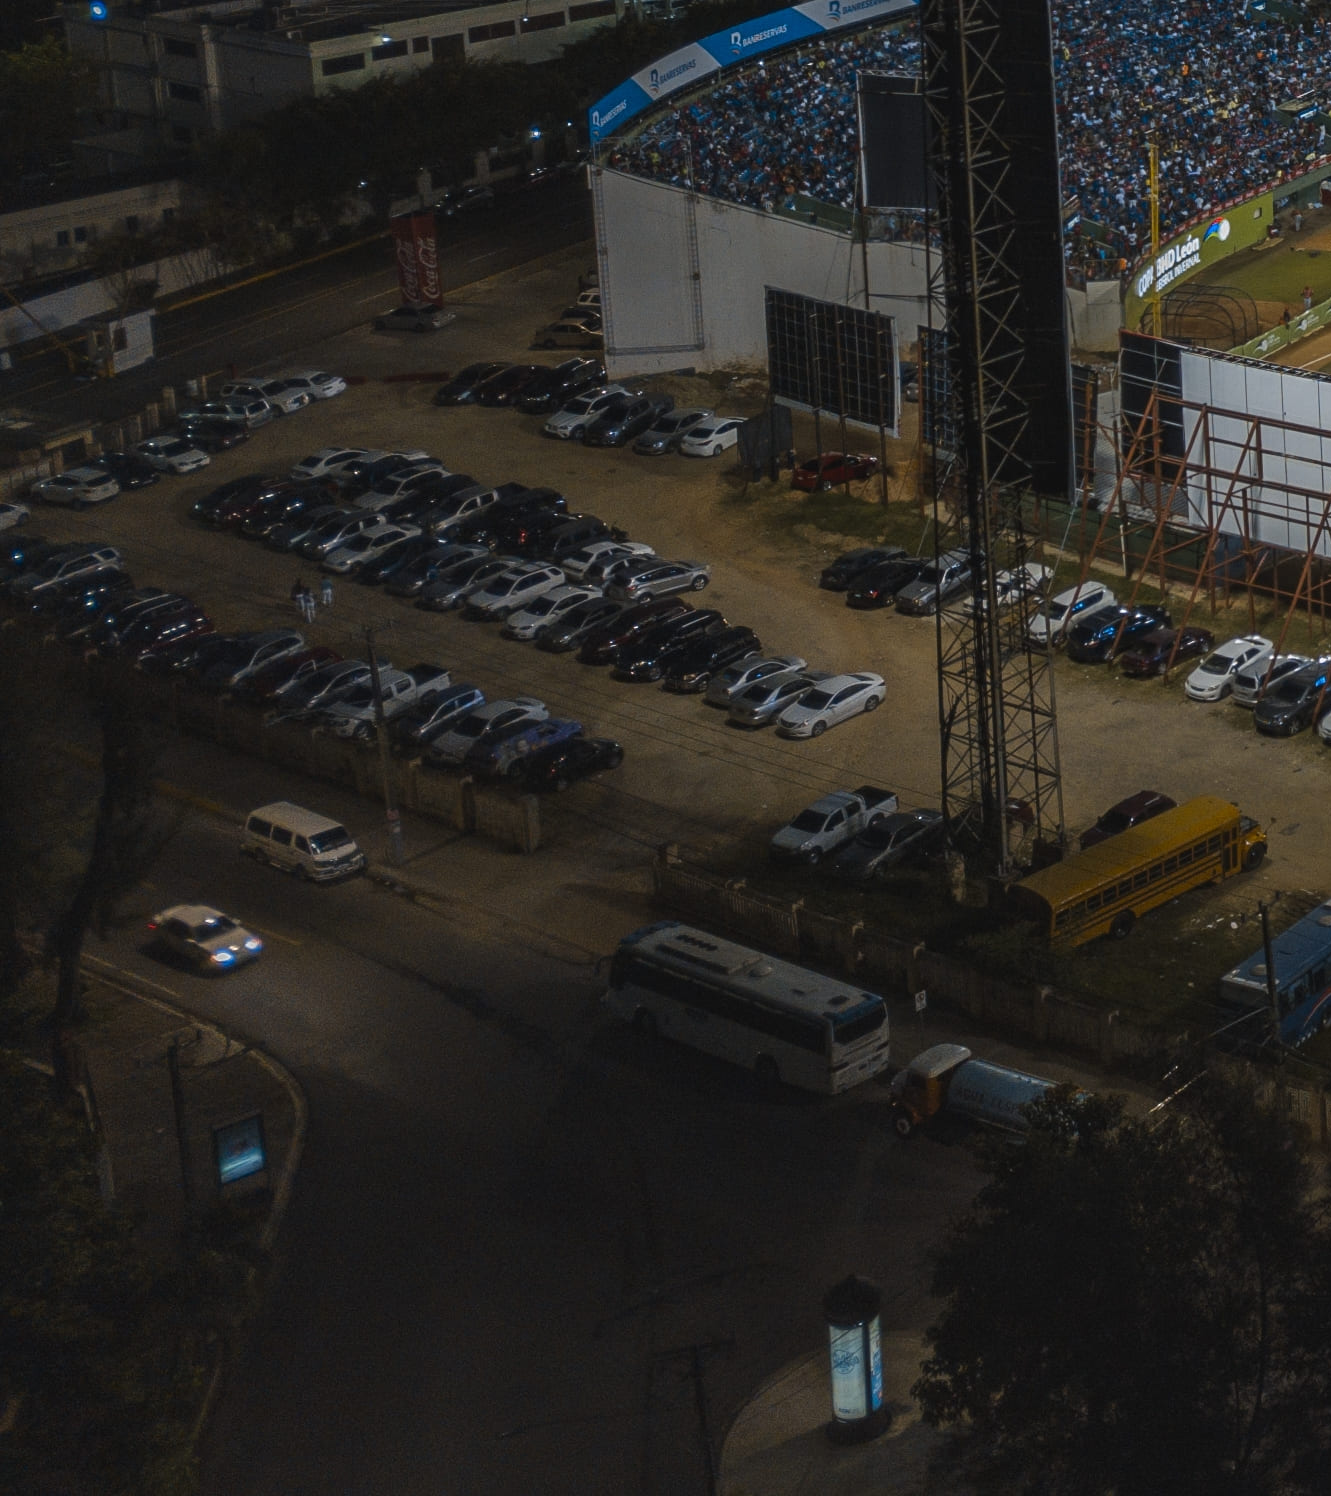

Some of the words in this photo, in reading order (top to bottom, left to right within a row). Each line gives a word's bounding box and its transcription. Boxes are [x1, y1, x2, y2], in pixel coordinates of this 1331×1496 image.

[742, 24, 788, 47] BANRESERVAS
[659, 58, 697, 84] BANRESERVAS
[1175, 234, 1200, 262] León
